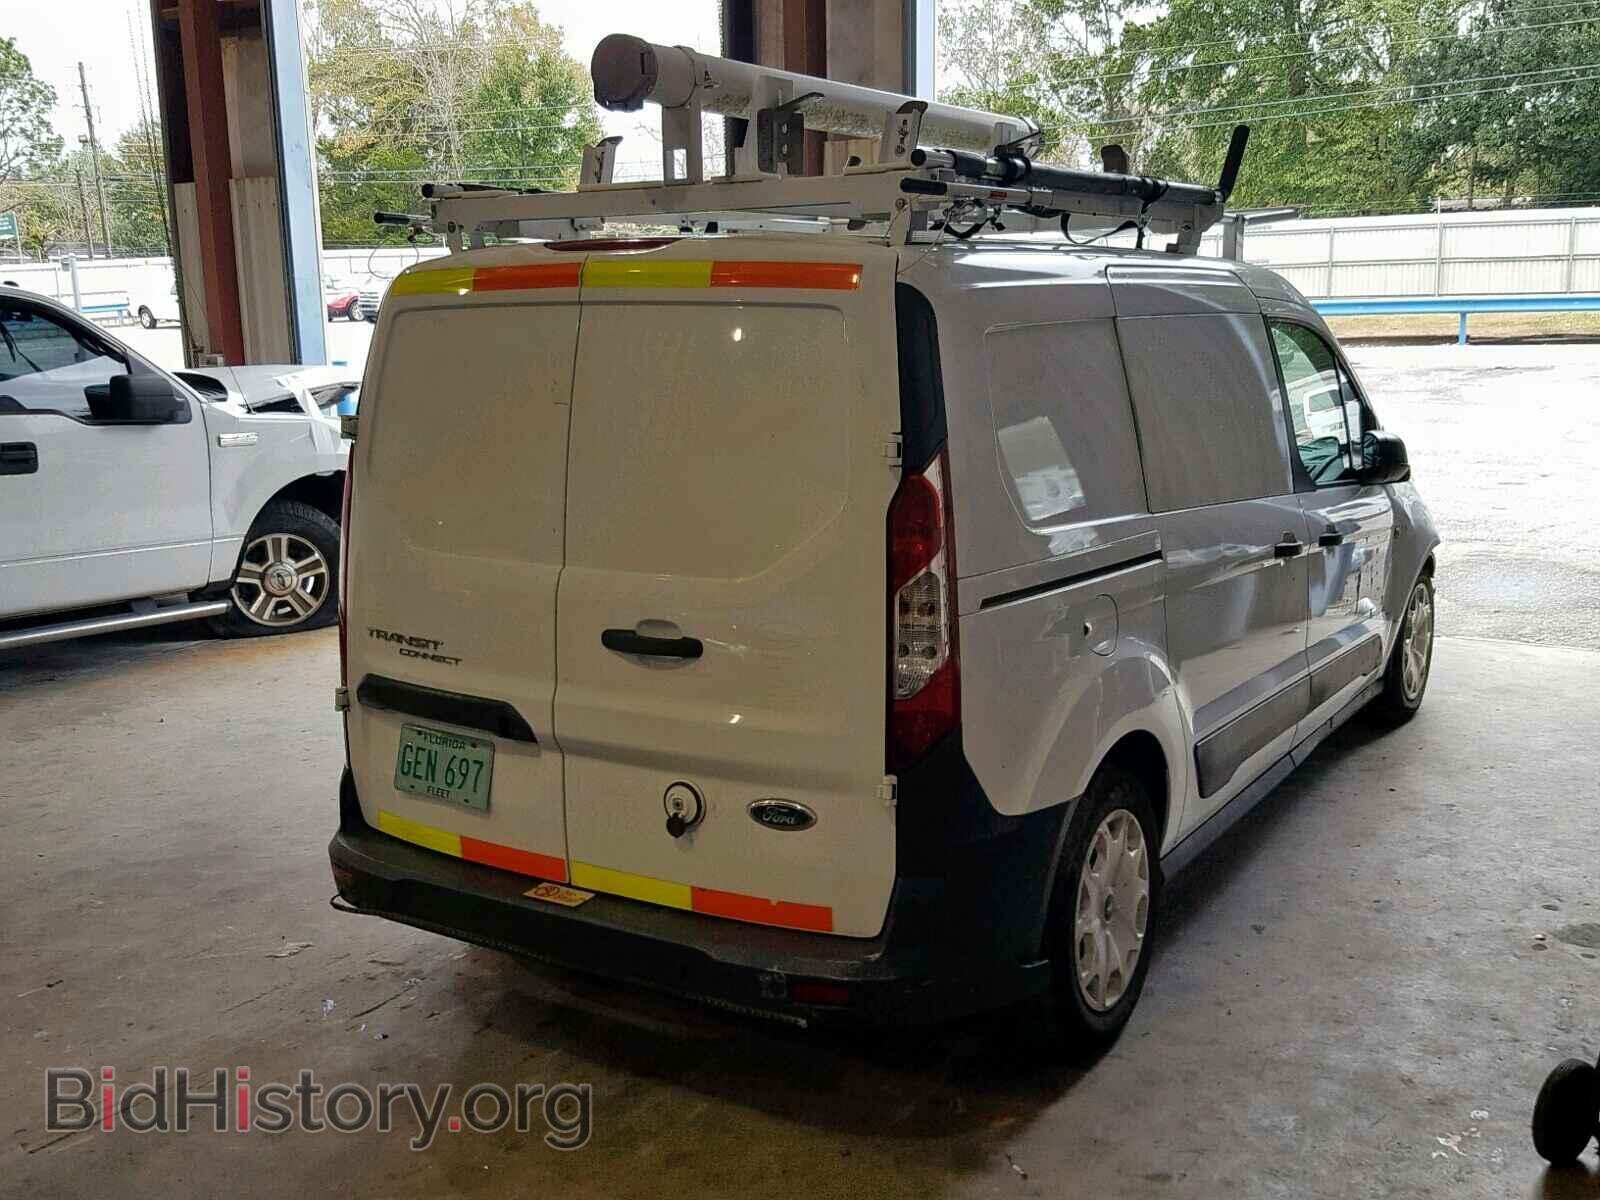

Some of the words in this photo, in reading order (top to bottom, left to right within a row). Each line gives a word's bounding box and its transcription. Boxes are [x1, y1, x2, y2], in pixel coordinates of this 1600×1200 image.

[367, 628, 444, 649] TRANSIT
[399, 648, 463, 665] CONNECT
[423, 731, 466, 750] FLORIDA
[400, 743, 438, 783] GEN
[444, 755, 484, 793] 697
[426, 785, 450, 799] FLEET
[762, 806, 795, 824] Ford
